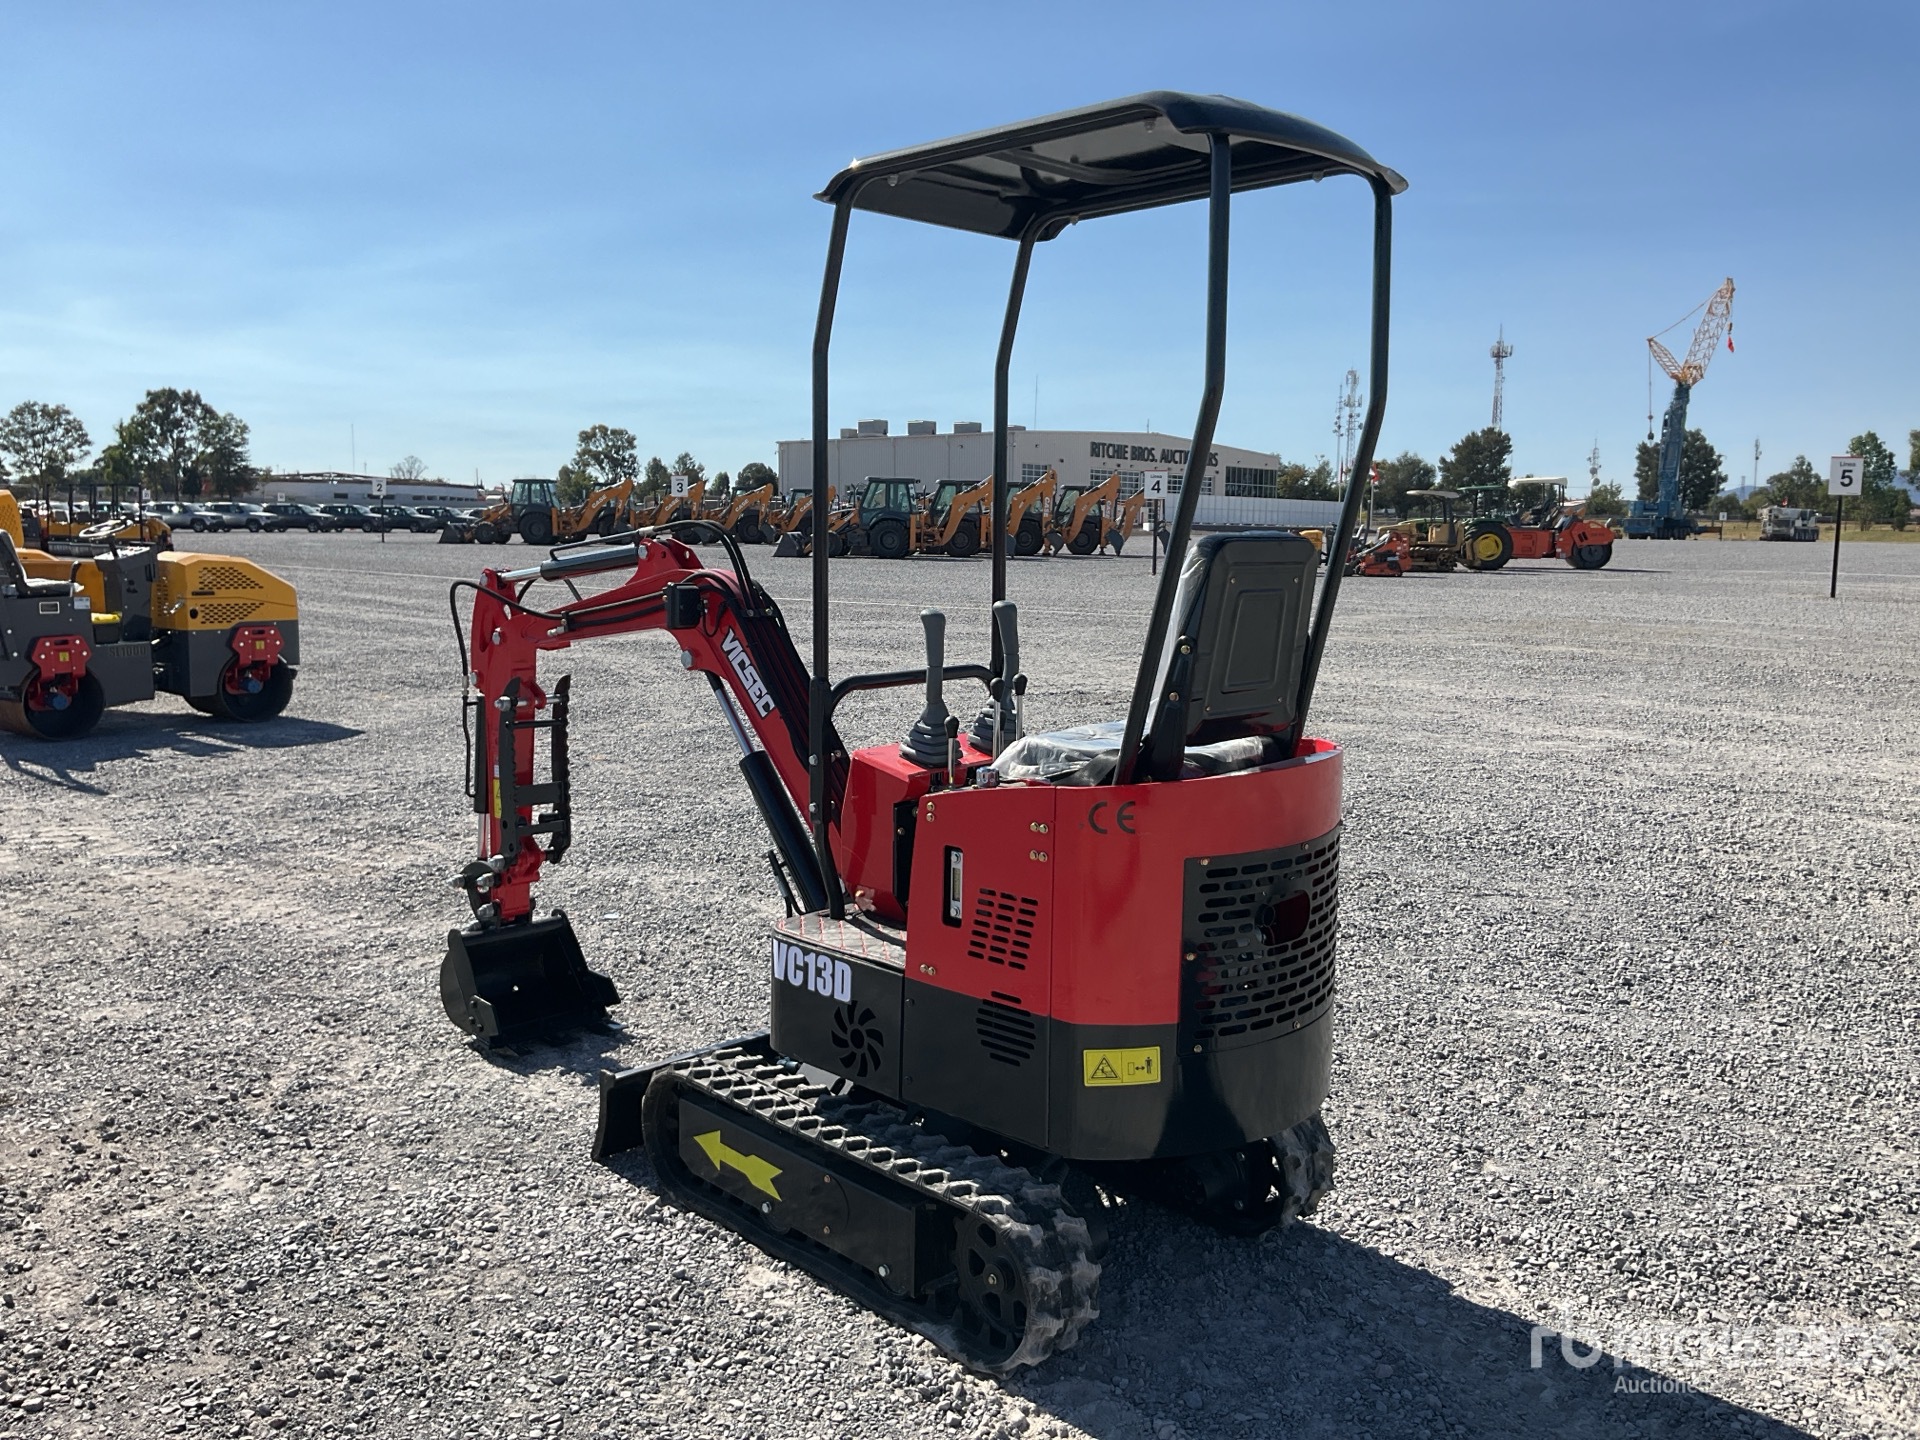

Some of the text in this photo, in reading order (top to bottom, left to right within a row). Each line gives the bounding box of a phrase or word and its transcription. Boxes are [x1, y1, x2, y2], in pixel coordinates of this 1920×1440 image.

[1090, 441, 1219, 468] RITCHIE BROS. AUCTIRS
[376, 483, 383, 492] 2
[676, 482, 684, 493] 3
[1151, 480, 1161, 493] 4
[1840, 469, 1853, 487] 5
[721, 627, 776, 718] VICSEC
[1088, 800, 1136, 834] CE
[772, 938, 852, 1003] VC13D
